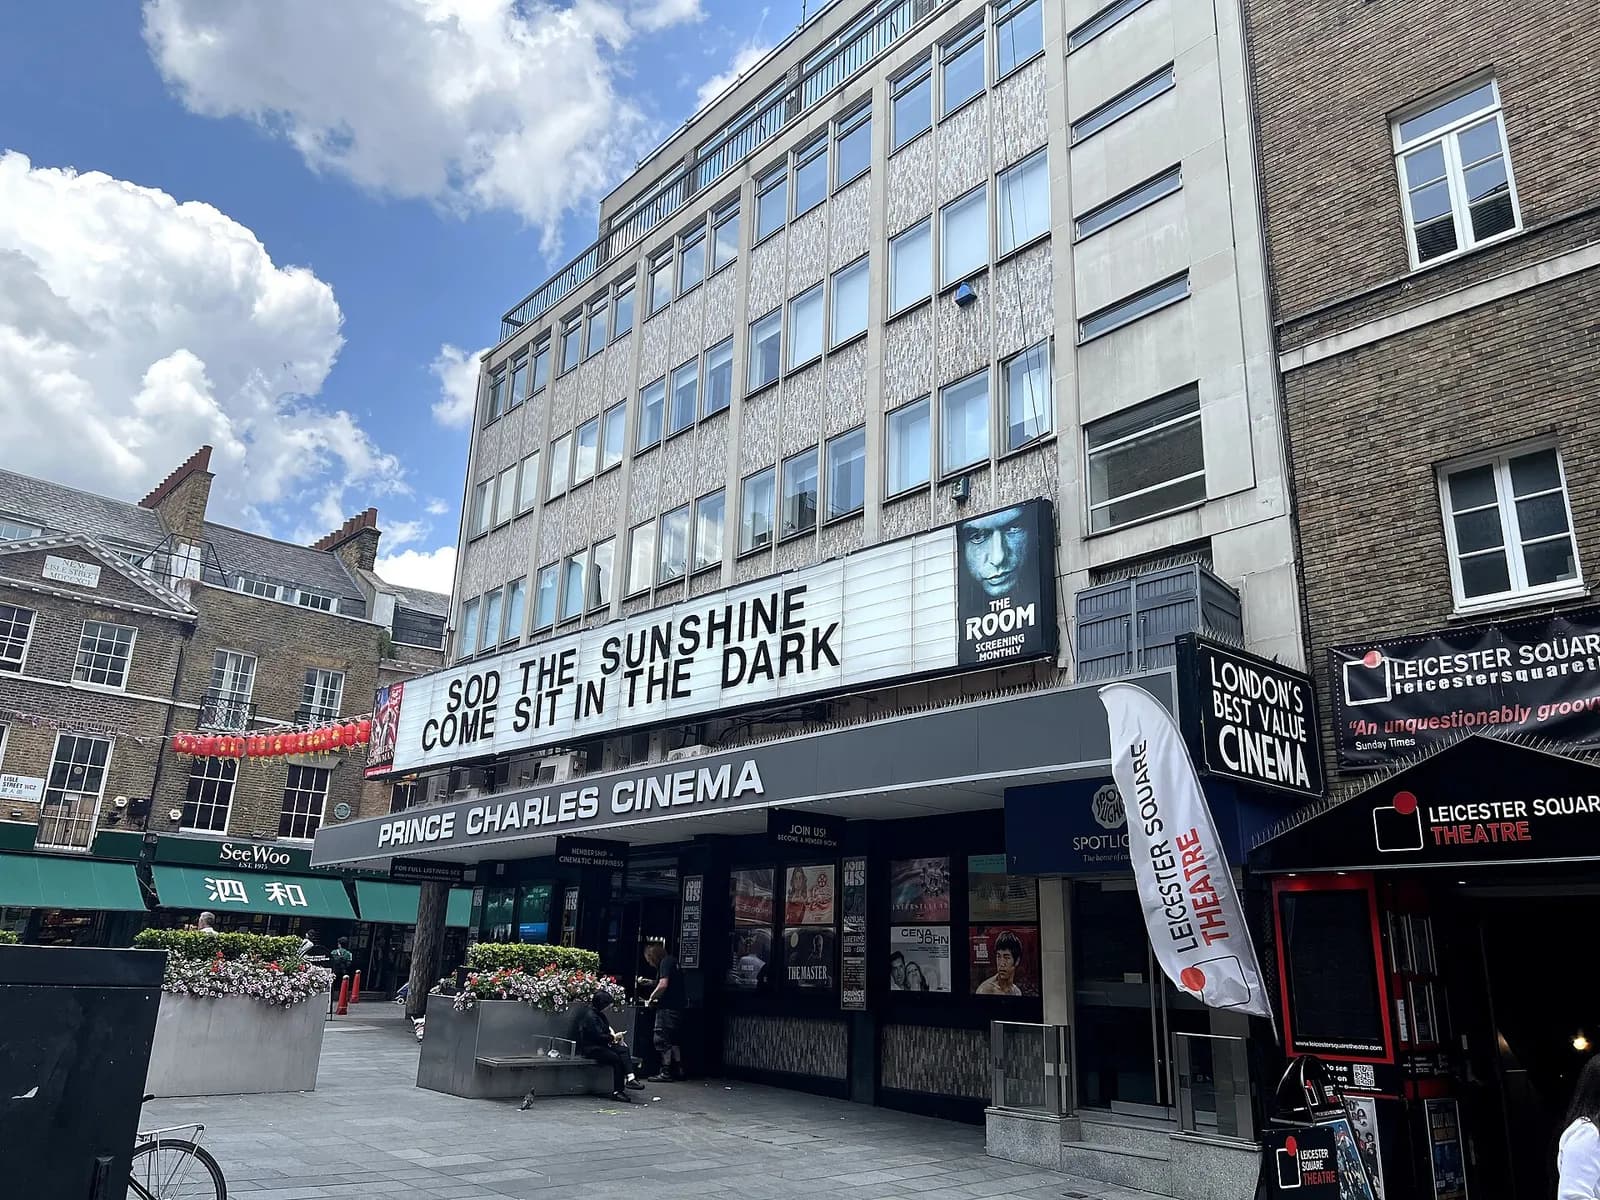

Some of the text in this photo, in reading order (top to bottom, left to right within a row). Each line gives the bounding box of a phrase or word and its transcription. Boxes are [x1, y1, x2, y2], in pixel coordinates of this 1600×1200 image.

[989, 597, 1011, 612] THE
[966, 603, 1035, 641] ROOM
[446, 584, 808, 712] SOD THE SUNSHINE
[975, 633, 1025, 653] SCREENING
[979, 644, 1022, 662] MONTHLY
[1393, 634, 1600, 681] LEICESTER SQUAR
[422, 622, 841, 752] COME SIT IN THE DARK
[1210, 656, 1304, 714] LONDON'S
[1395, 655, 1600, 696] leicestersquaret
[1213, 689, 1307, 743] BEST VALUE
[1384, 703, 1531, 735] unquestionably
[1218, 724, 1311, 789] CINEMA
[1355, 738, 1416, 751] Sunday Times
[2, 781, 23, 789] STREET
[377, 759, 764, 848] PRINCE CHARLES CINEMA
[1429, 795, 1600, 823] LEICESTER SQUAR
[790, 825, 826, 838] JOIN US!
[1073, 834, 1129, 851] SPOTLIG
[1430, 820, 1532, 846] THEATRE
[1130, 739, 1199, 953] LEICESTER SQUARE
[559, 855, 592, 865] CINEMATIC
[204, 877, 308, 907] 泗和
[1175, 827, 1230, 946] THEATRE
[917, 936, 949, 945] JOHN
[788, 966, 800, 980] THE
[801, 965, 828, 980] MASTER
[1295, 1040, 1383, 1052] www.leicestersquaretheatre.com
[1300, 1148, 1329, 1160] LEICESTER
[1301, 1160, 1324, 1172] SQUARE
[1303, 1171, 1336, 1187] THEATRE
